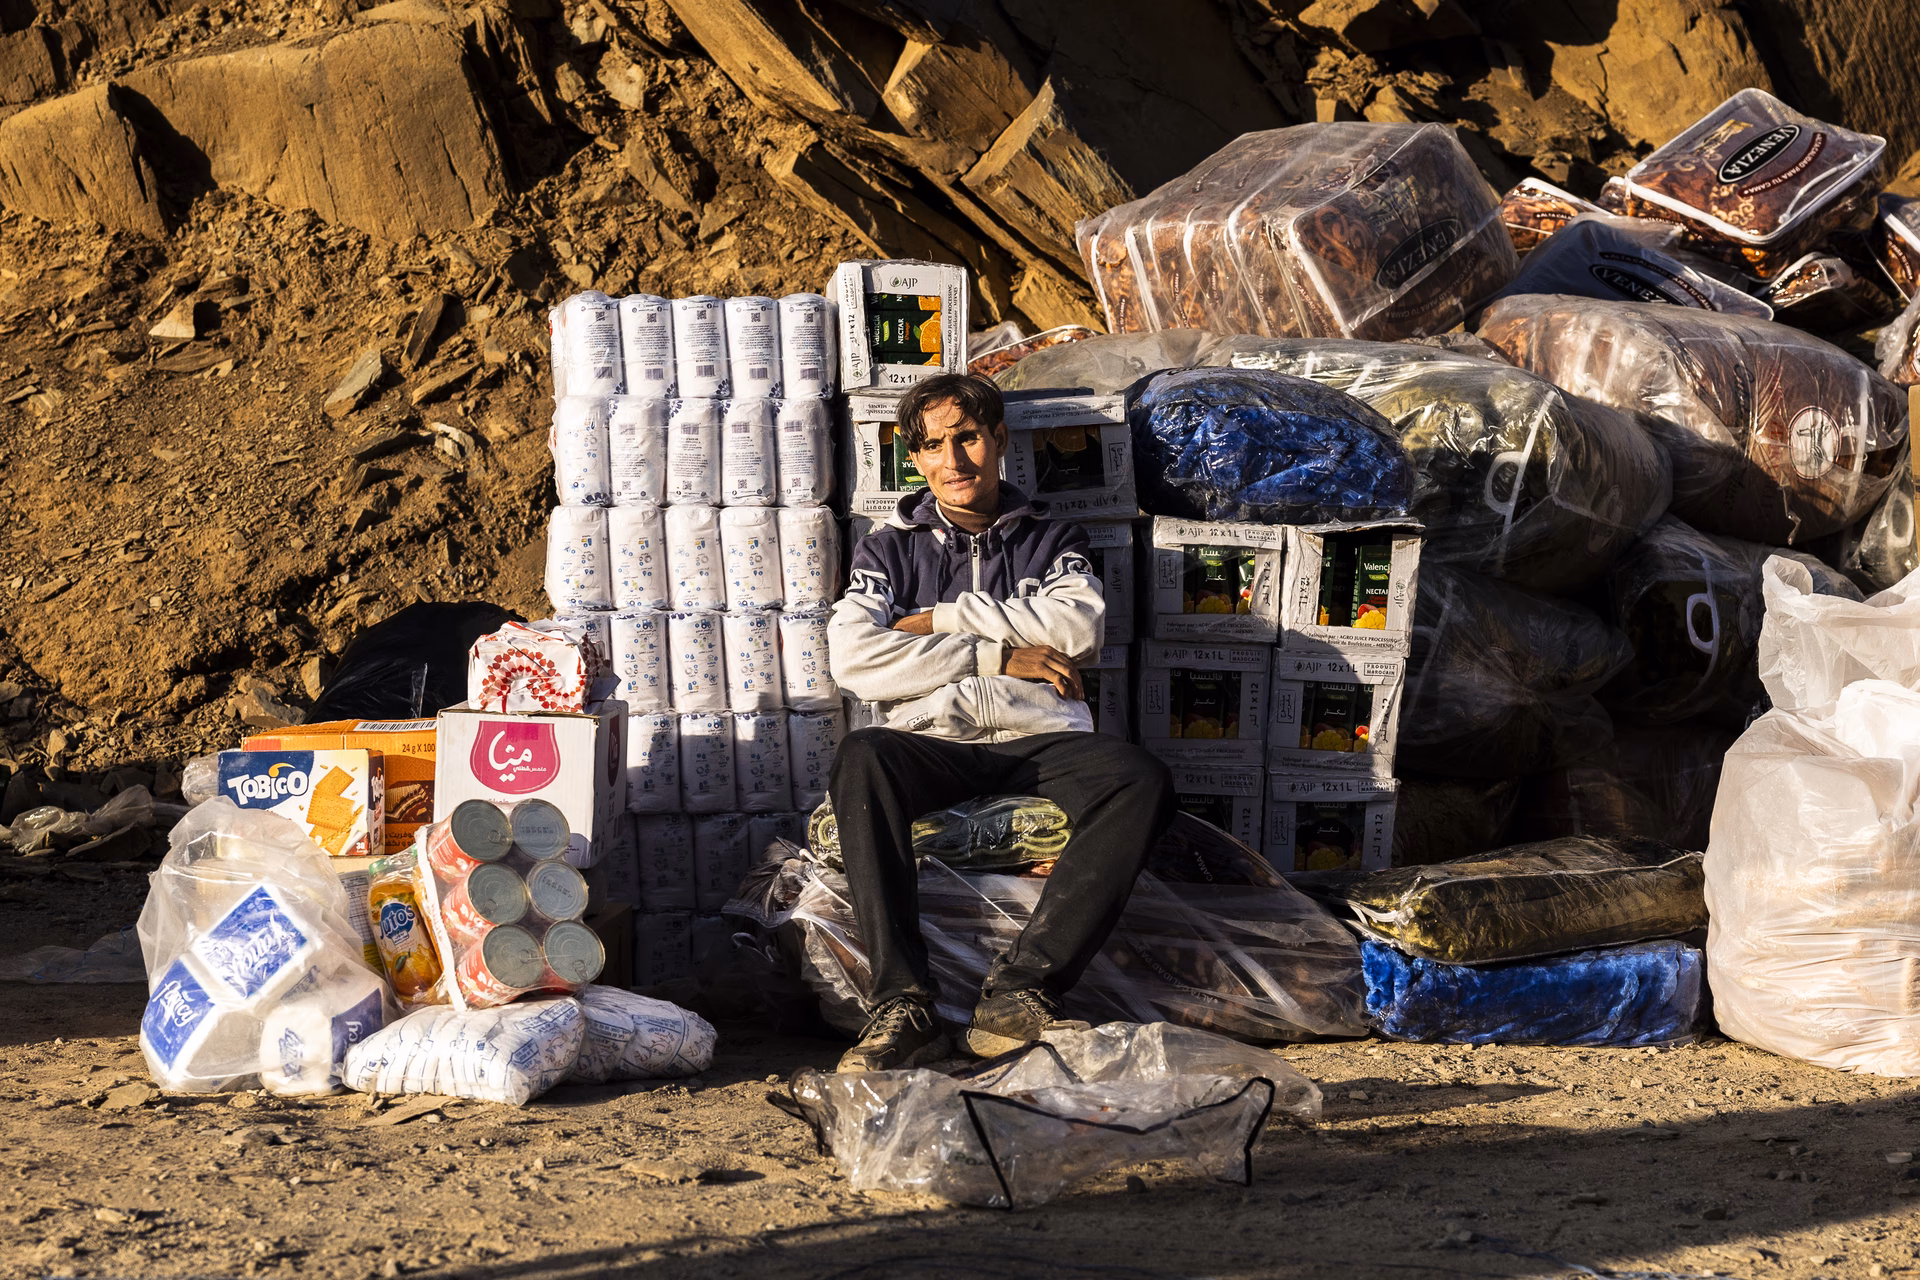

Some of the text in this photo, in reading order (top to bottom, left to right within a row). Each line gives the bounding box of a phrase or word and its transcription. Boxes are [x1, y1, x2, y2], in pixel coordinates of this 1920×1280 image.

[1724, 128, 1795, 175] VENEZIA
[1783, 166, 1801, 180] PARA
[1748, 182, 1772, 193] CAMA
[1772, 177, 1782, 186] TU
[1385, 223, 1458, 281] VENEZIA
[901, 277, 918, 290] AJP
[1601, 268, 1668, 303] VENEZ
[1427, 295, 1443, 311] PARA
[1390, 310, 1410, 319] CAMA
[1411, 307, 1425, 317] TU
[848, 314, 855, 323] 12
[872, 314, 881, 347] Valencia
[850, 352, 863, 368] AJP
[888, 373, 912, 384] 12 x 1
[863, 440, 875, 458] AJP
[1018, 474, 1027, 486] 12
[1056, 502, 1063, 512] L
[1064, 501, 1069, 511] 1
[1079, 500, 1088, 509] 12
[1093, 496, 1109, 507] AJP
[1188, 528, 1204, 538] AJP
[1209, 528, 1218, 537] 12
[1228, 529, 1232, 537] 1
[1234, 529, 1240, 538] L
[1263, 561, 1271, 573] 12
[1111, 579, 1122, 593] AJP
[1394, 594, 1404, 608] AJP
[1172, 649, 1188, 660] AJP
[1193, 650, 1203, 660] 12
[1211, 651, 1216, 660] 1
[1218, 651, 1224, 660] L
[1305, 662, 1322, 673] AJP
[1327, 662, 1358, 673] 12 x 1 L
[1250, 682, 1259, 694] 12
[1105, 703, 1116, 717] AJP
[402, 743, 436, 754] 24 g X 100
[1185, 773, 1195, 784] 12
[1203, 775, 1208, 784] 1
[1209, 776, 1215, 785] L
[227, 769, 309, 806] TOBIGO
[1299, 782, 1316, 794] AJP
[1321, 782, 1331, 792] 12
[1339, 783, 1344, 792] 1
[1346, 783, 1352, 792] L
[1242, 807, 1251, 819] 12
[1375, 814, 1384, 825] 12
[1197, 855, 1213, 882] CAMA
[1152, 962, 1214, 1004] ALTA CALIDAD
